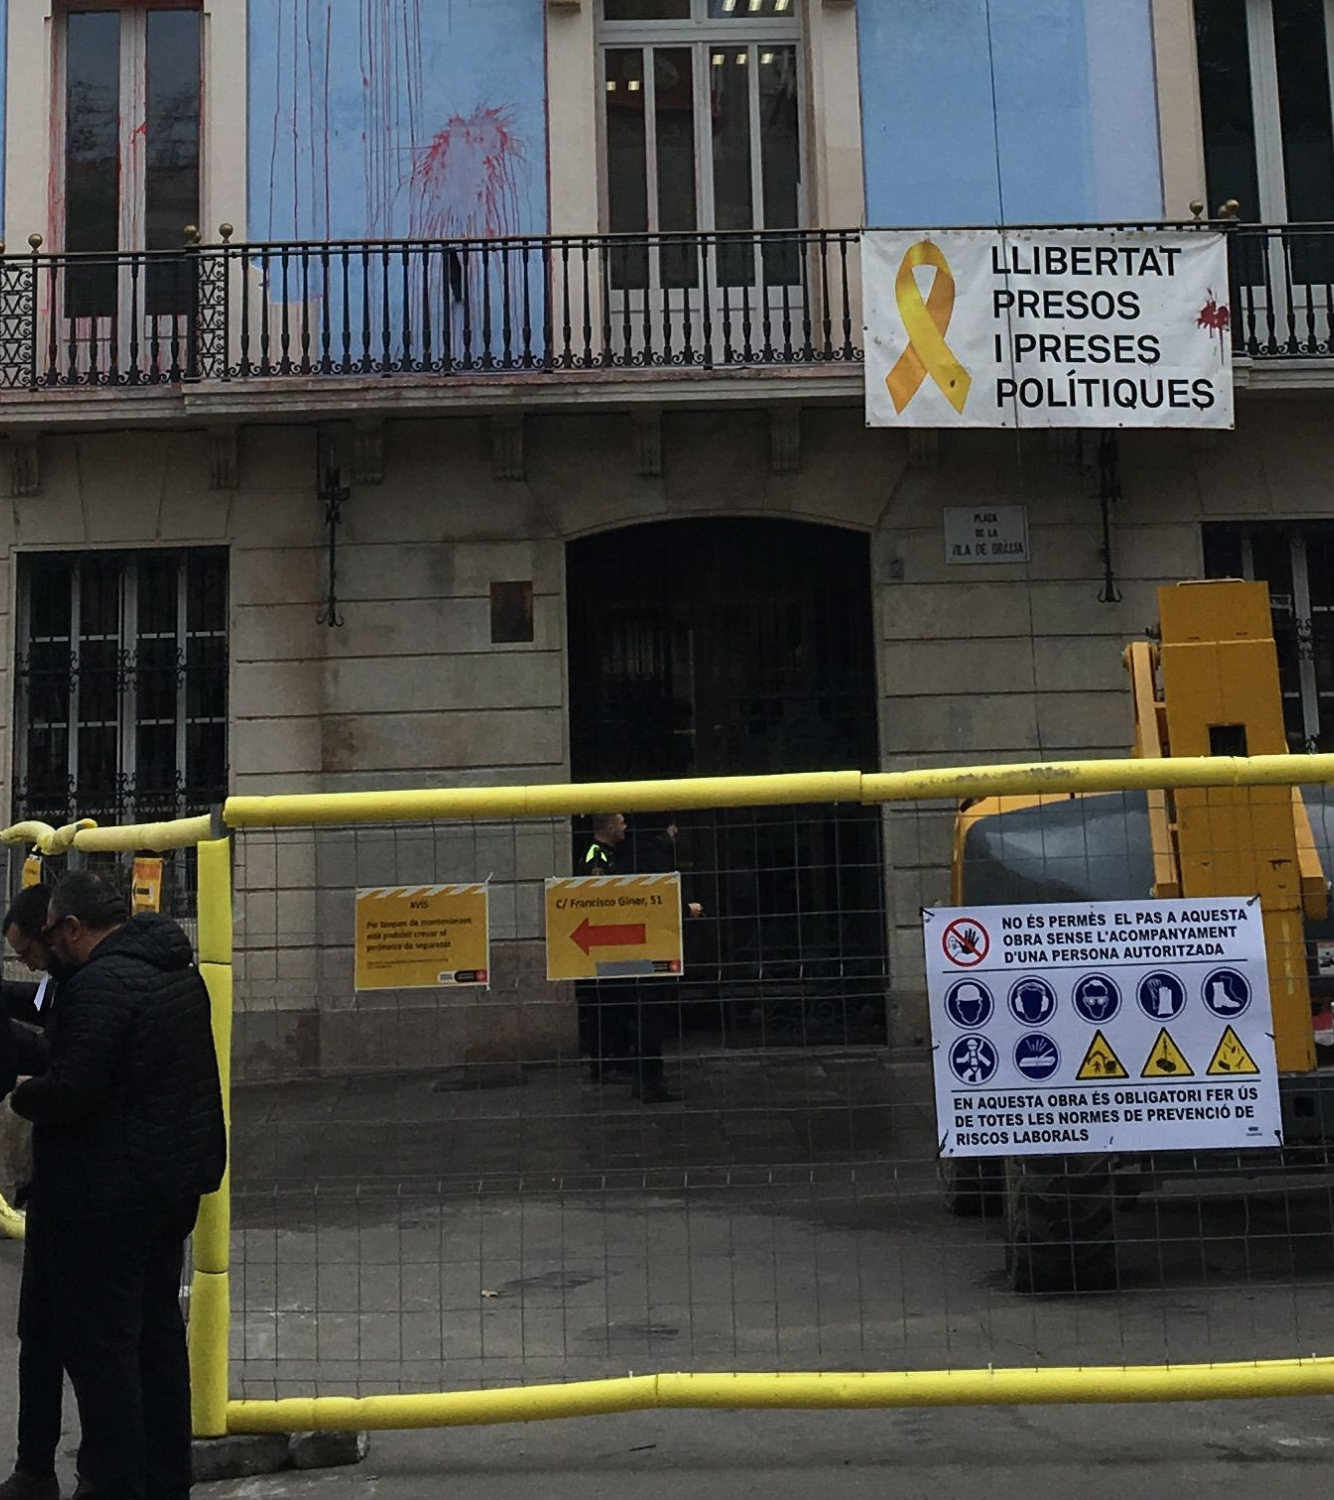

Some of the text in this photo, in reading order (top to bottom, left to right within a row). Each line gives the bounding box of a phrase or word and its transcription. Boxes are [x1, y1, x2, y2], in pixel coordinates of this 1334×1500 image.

[991, 245, 1182, 277] LLIBERTAT
[993, 289, 1141, 320] PRESOS
[995, 333, 1161, 364] I PRESES
[996, 368, 1215, 410] POLÍTIQUES
[975, 528, 998, 538] DE LA
[975, 542, 987, 556] DE
[556, 895, 663, 910] C/ Francisco Giner, 51
[1002, 908, 1247, 930] NO ÉS PERMÈS EL PAS A AQUESTA
[404, 941, 414, 950] de
[1003, 926, 1237, 947] OBRA SENSE L'ACOMPANYAMENT
[1004, 943, 1225, 964] D'UNA PERSONA AUTORITZADA
[954, 1086, 1258, 1111] EN AQUESTA OBRA ÉS OBLIGATORI FER ÚS
[954, 1103, 1254, 1128] DE TOTES LES NORMES DE PREVENCIÓ DE
[956, 1128, 1089, 1146] RISCOS LABORALS
